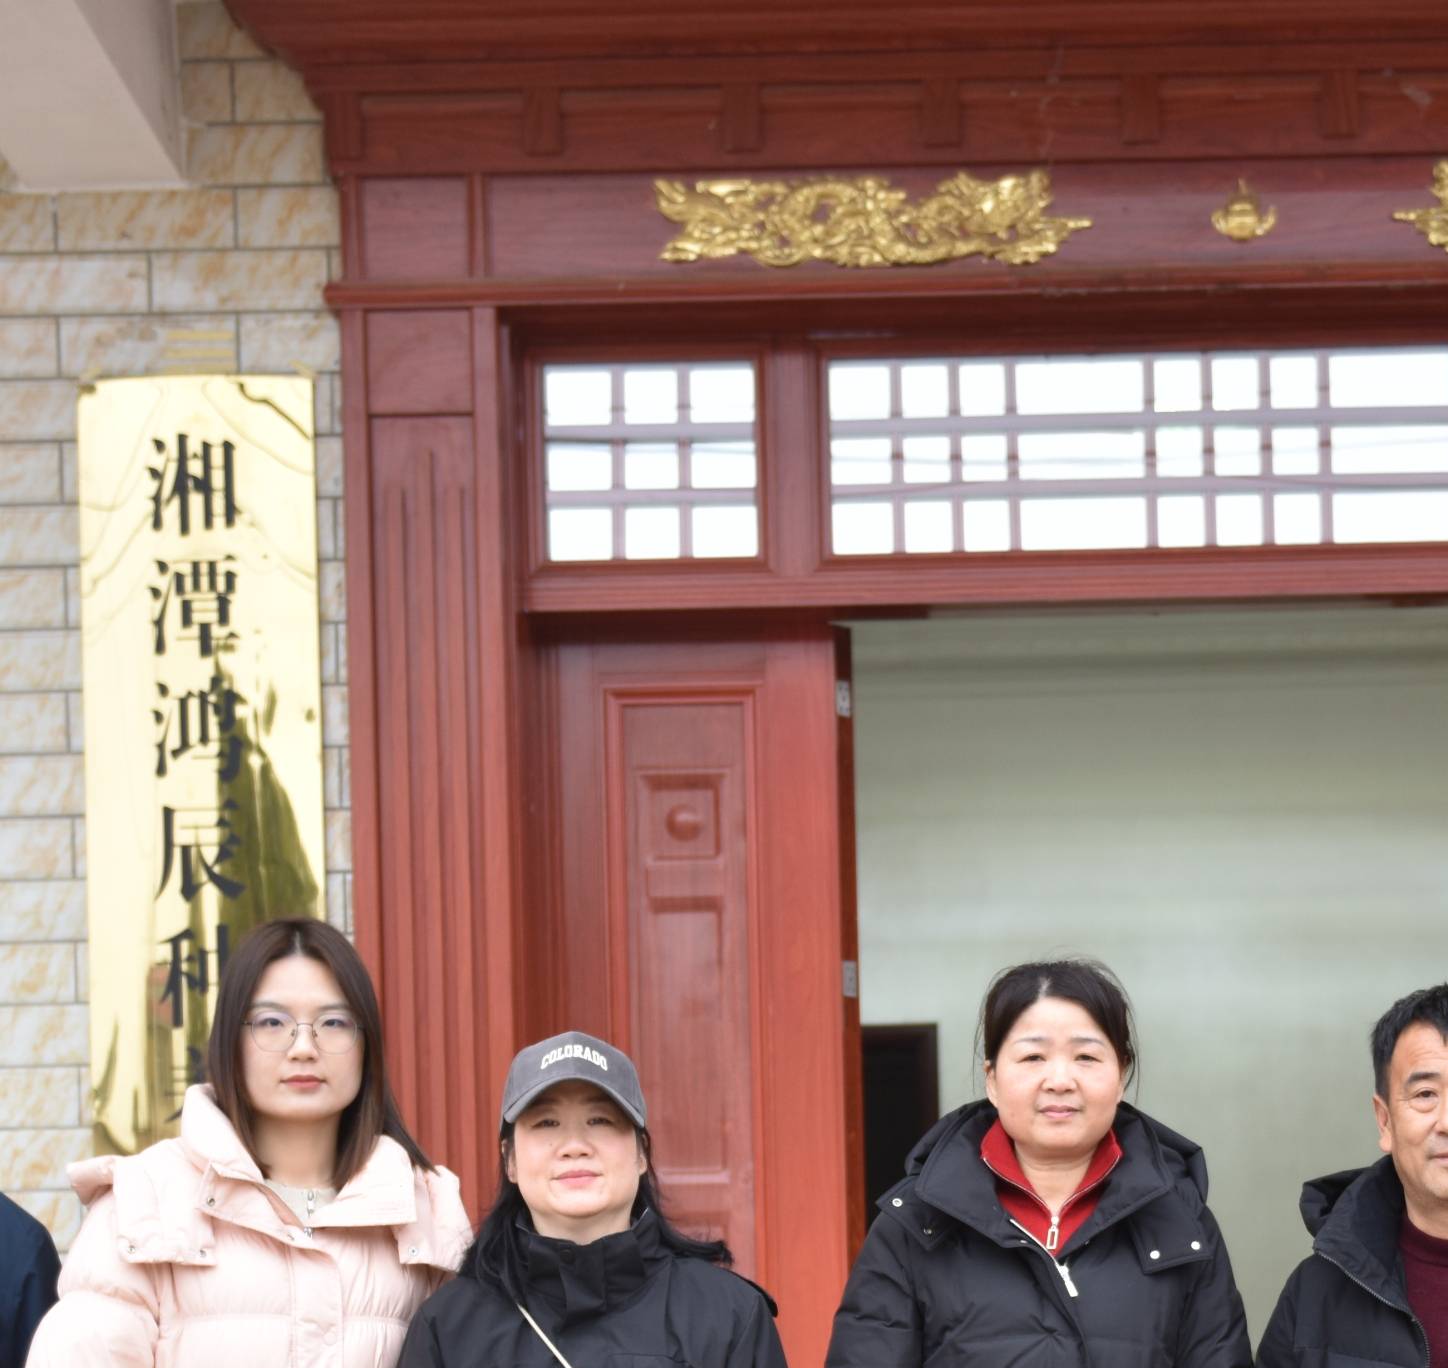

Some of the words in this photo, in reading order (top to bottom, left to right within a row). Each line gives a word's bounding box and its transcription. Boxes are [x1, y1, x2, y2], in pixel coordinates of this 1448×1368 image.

[148, 432, 246, 1124] 湘潭鸿辰种
[540, 1044, 609, 1071] COLORADO
